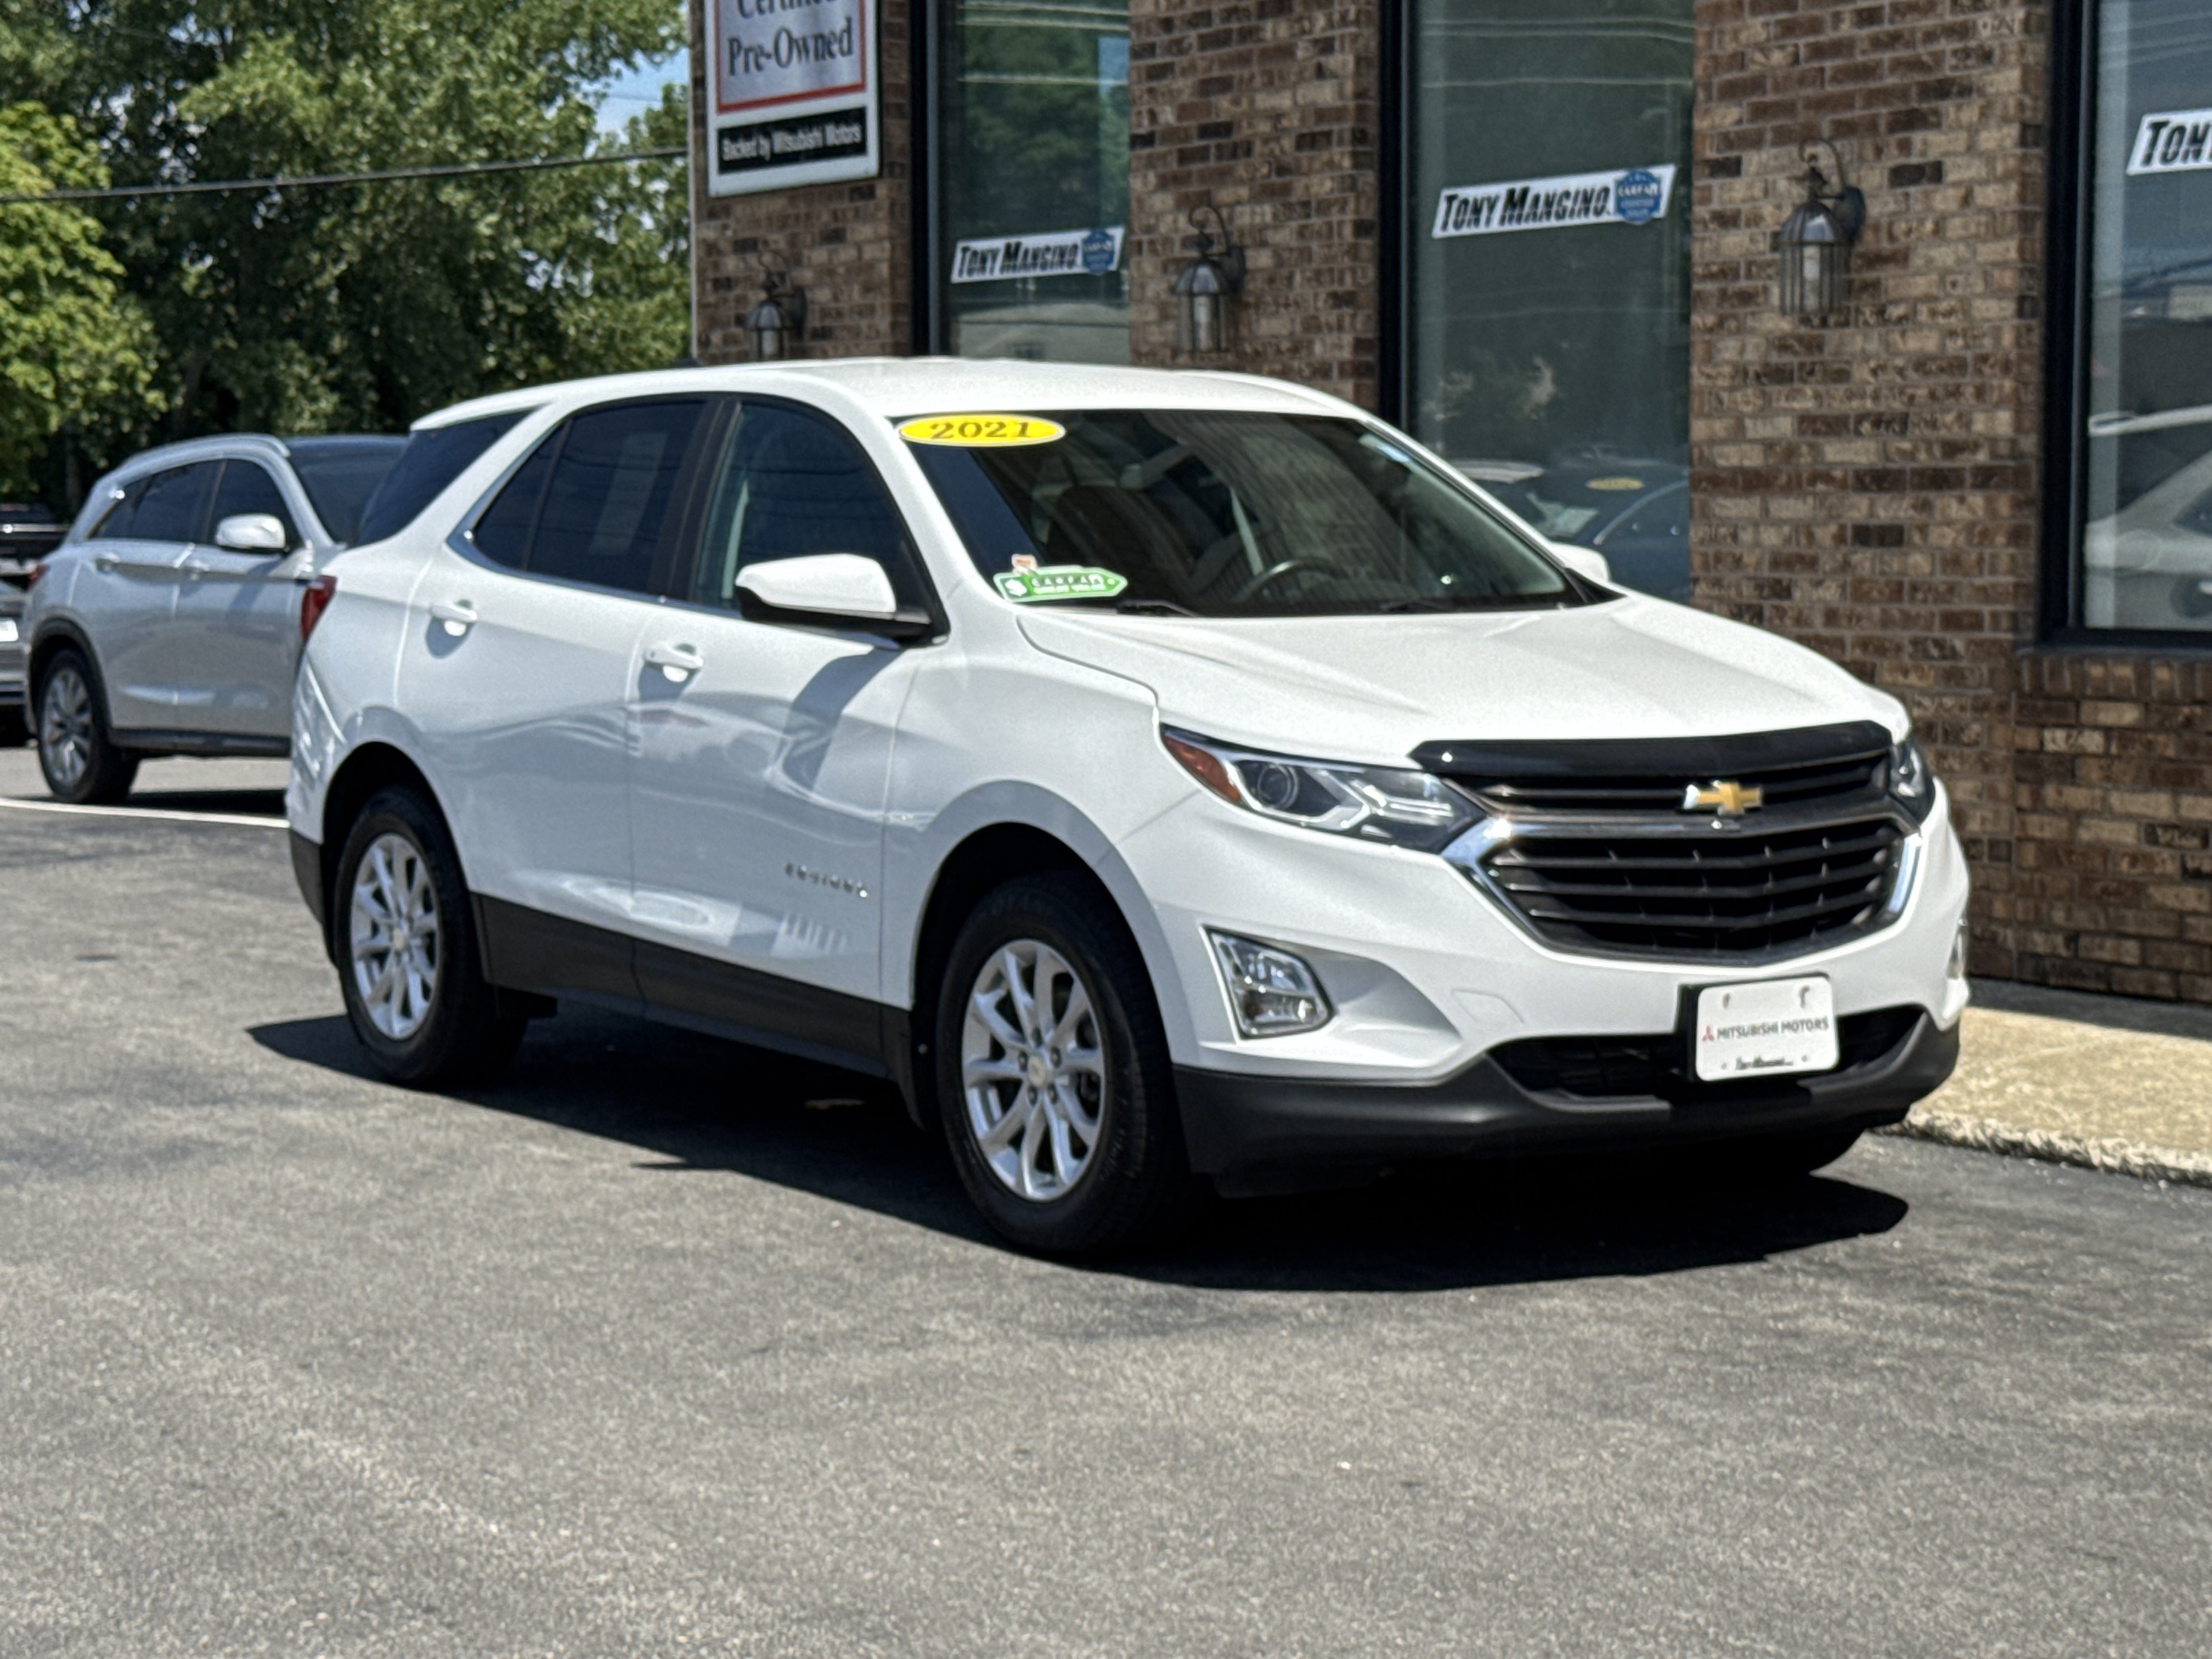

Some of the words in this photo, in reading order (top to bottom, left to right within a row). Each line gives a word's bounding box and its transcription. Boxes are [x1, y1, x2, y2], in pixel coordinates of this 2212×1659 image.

[727, 17, 853, 76] Pre-Owned
[2140, 120, 2212, 167] TON
[1440, 193, 1499, 232] TONY
[1498, 186, 1611, 227] MANGINO
[958, 245, 1001, 278] TONY
[998, 240, 1079, 274] MANGINO
[930, 421, 1030, 439] 2021
[1717, 1020, 1779, 1041] MITSUBISHI
[1780, 1016, 1830, 1034] MOTORS
